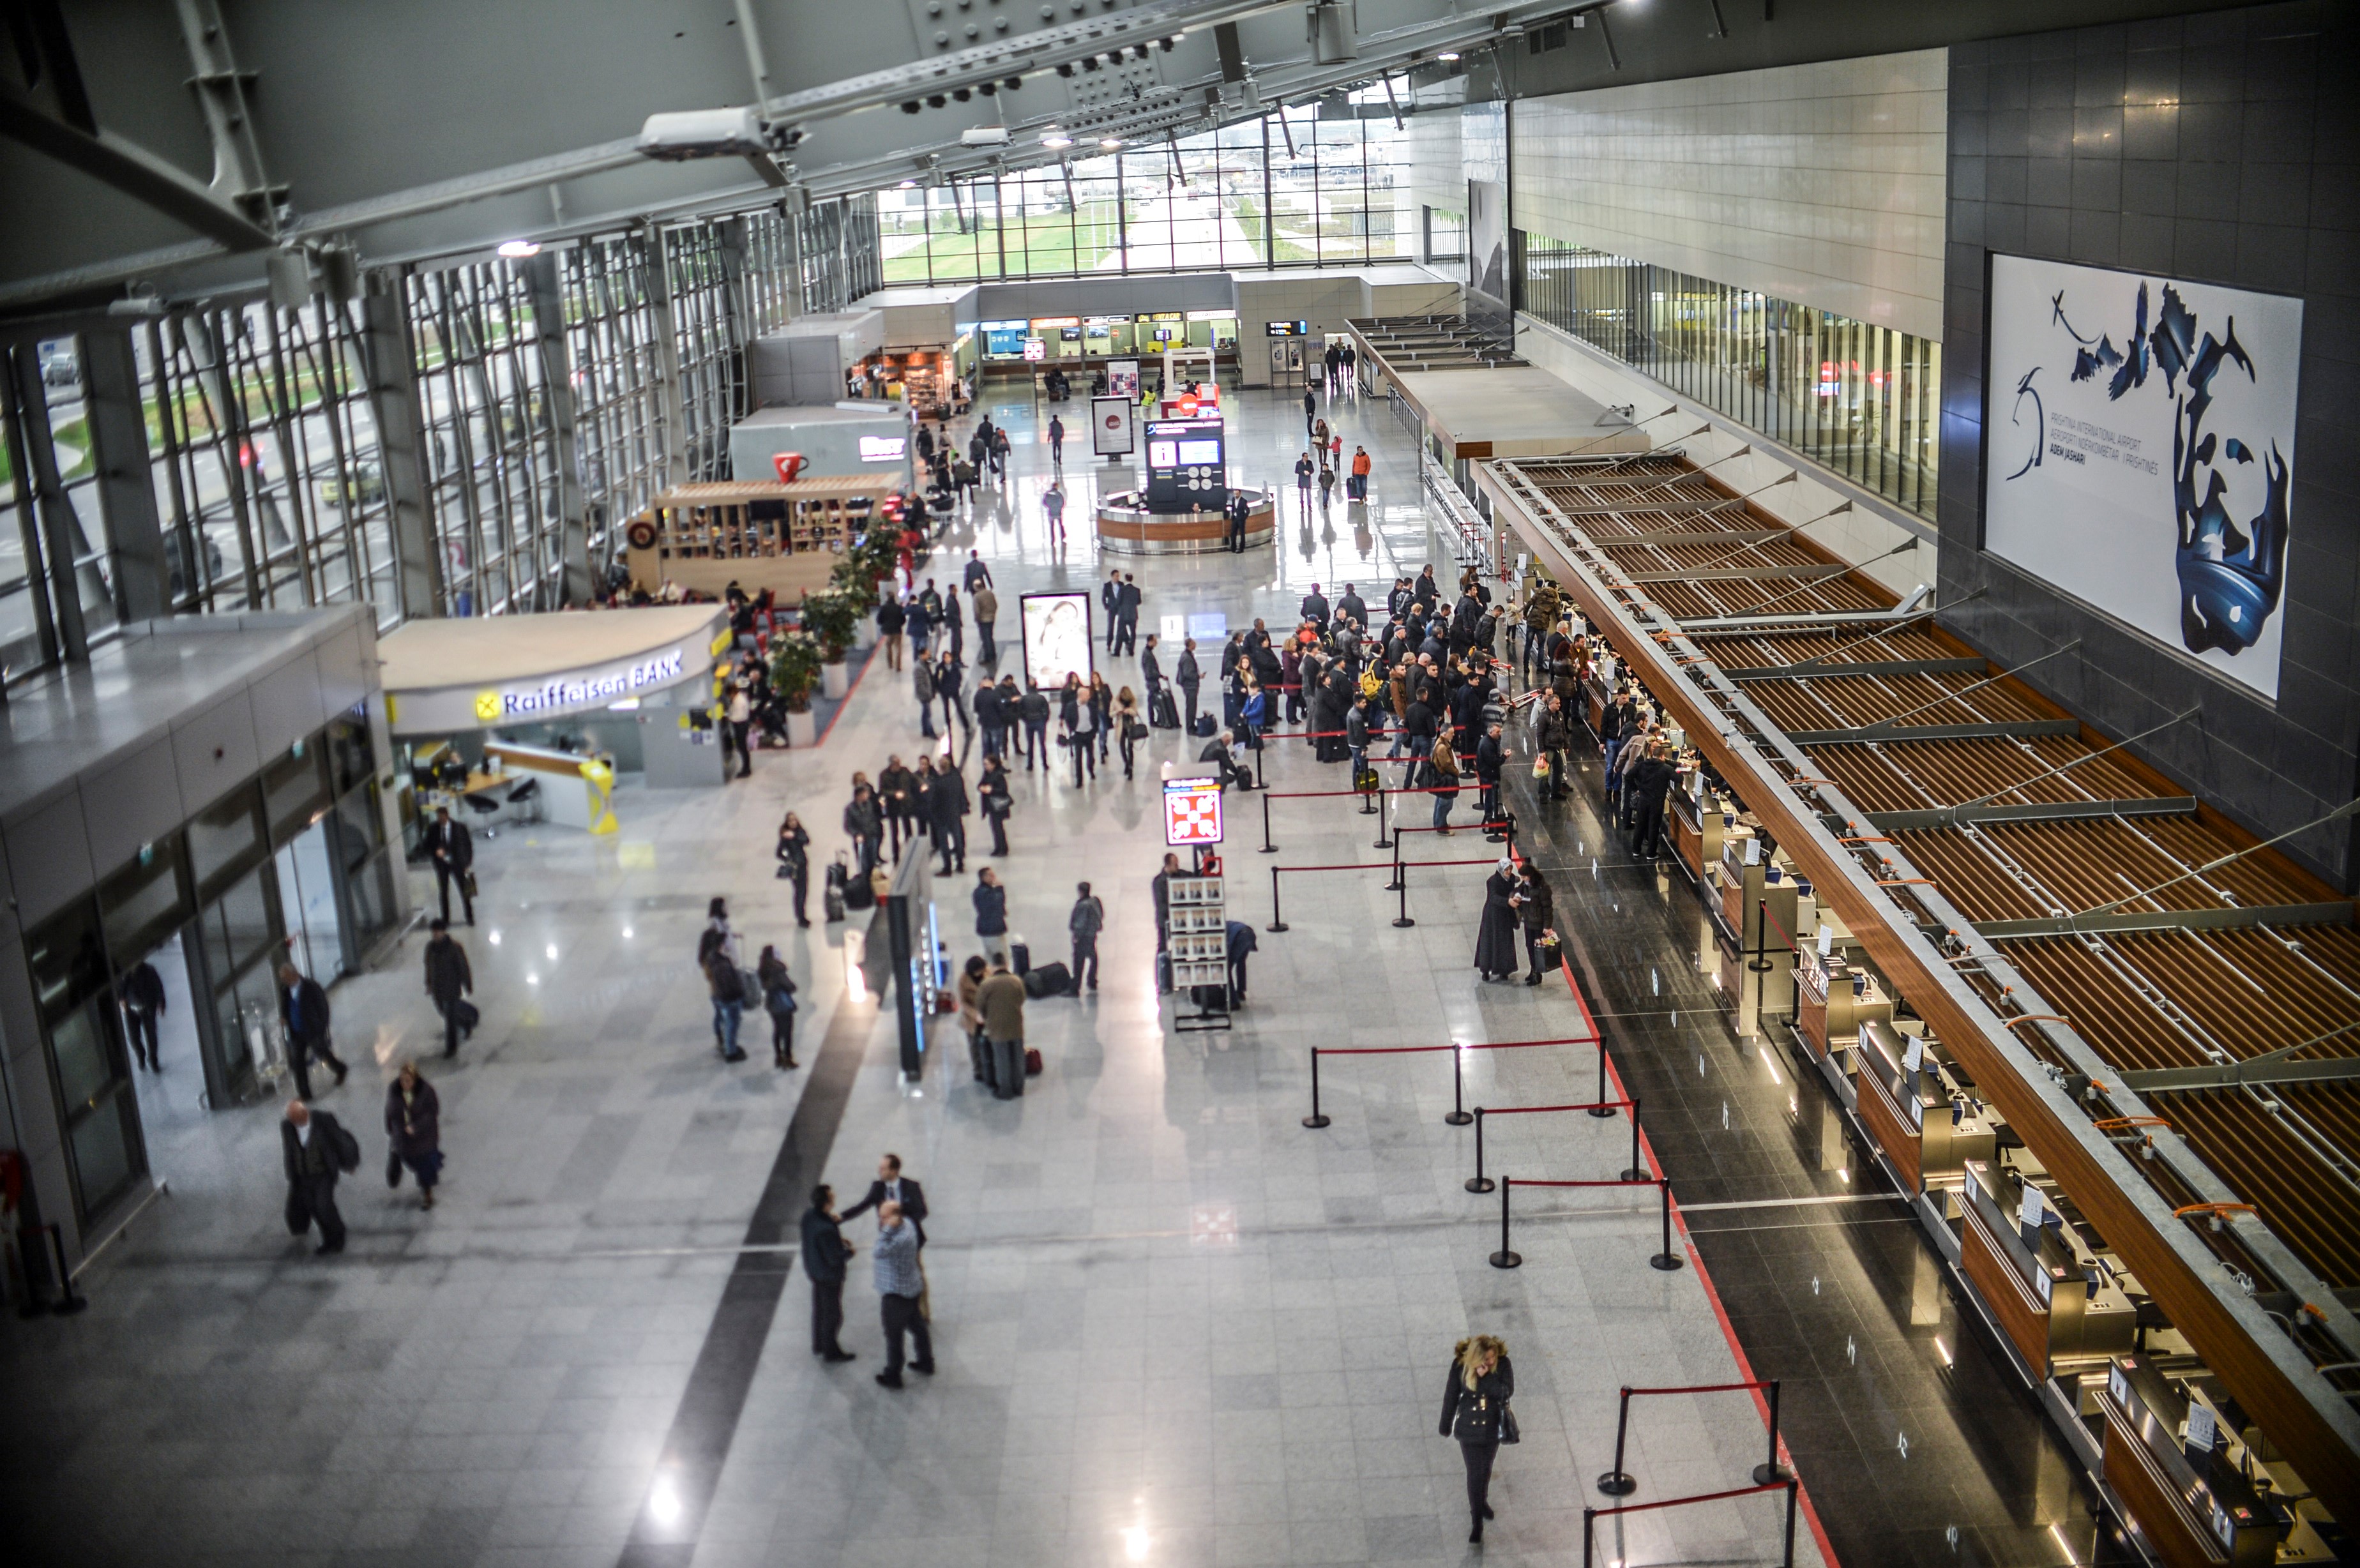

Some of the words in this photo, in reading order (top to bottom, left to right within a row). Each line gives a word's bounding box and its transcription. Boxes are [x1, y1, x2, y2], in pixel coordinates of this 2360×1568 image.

[2050, 412, 2076, 430] PRISHTINA
[2076, 419, 2116, 444] INTERNATIONAL
[2117, 434, 2141, 452] AIRPORT
[2050, 428, 2077, 447] AEROPORTI
[2050, 443, 2064, 457] ADEM
[2063, 448, 2085, 465] JASHARI
[504, 679, 626, 713] Raiffeisen
[629, 649, 681, 688] BANK
